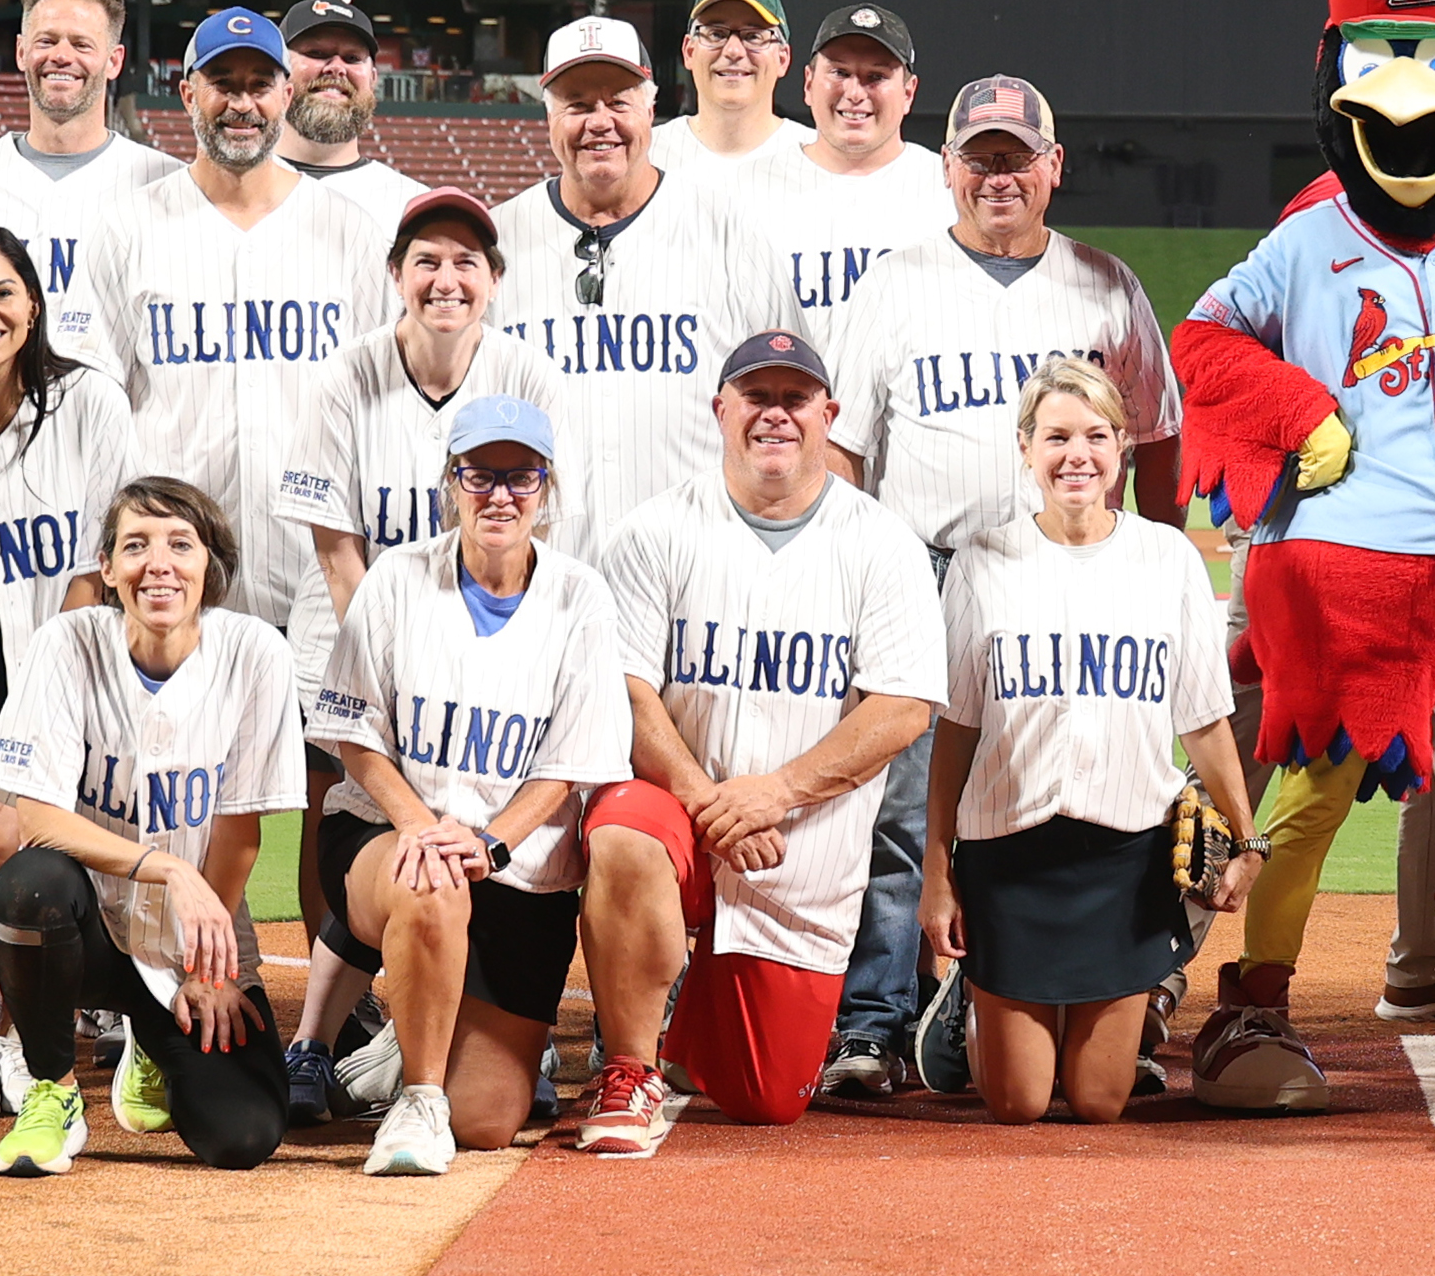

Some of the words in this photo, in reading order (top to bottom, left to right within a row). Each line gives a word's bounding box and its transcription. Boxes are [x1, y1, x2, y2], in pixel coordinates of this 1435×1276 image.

[227, 17, 252, 34] C
[148, 300, 342, 365] ILLINOIS
[282, 470, 331, 492] GREATER
[291, 485, 312, 499] LOUIS
[991, 631, 1169, 704] ILLINOIS
[319, 688, 368, 713] GREATER
[327, 704, 351, 719] LOUIS
